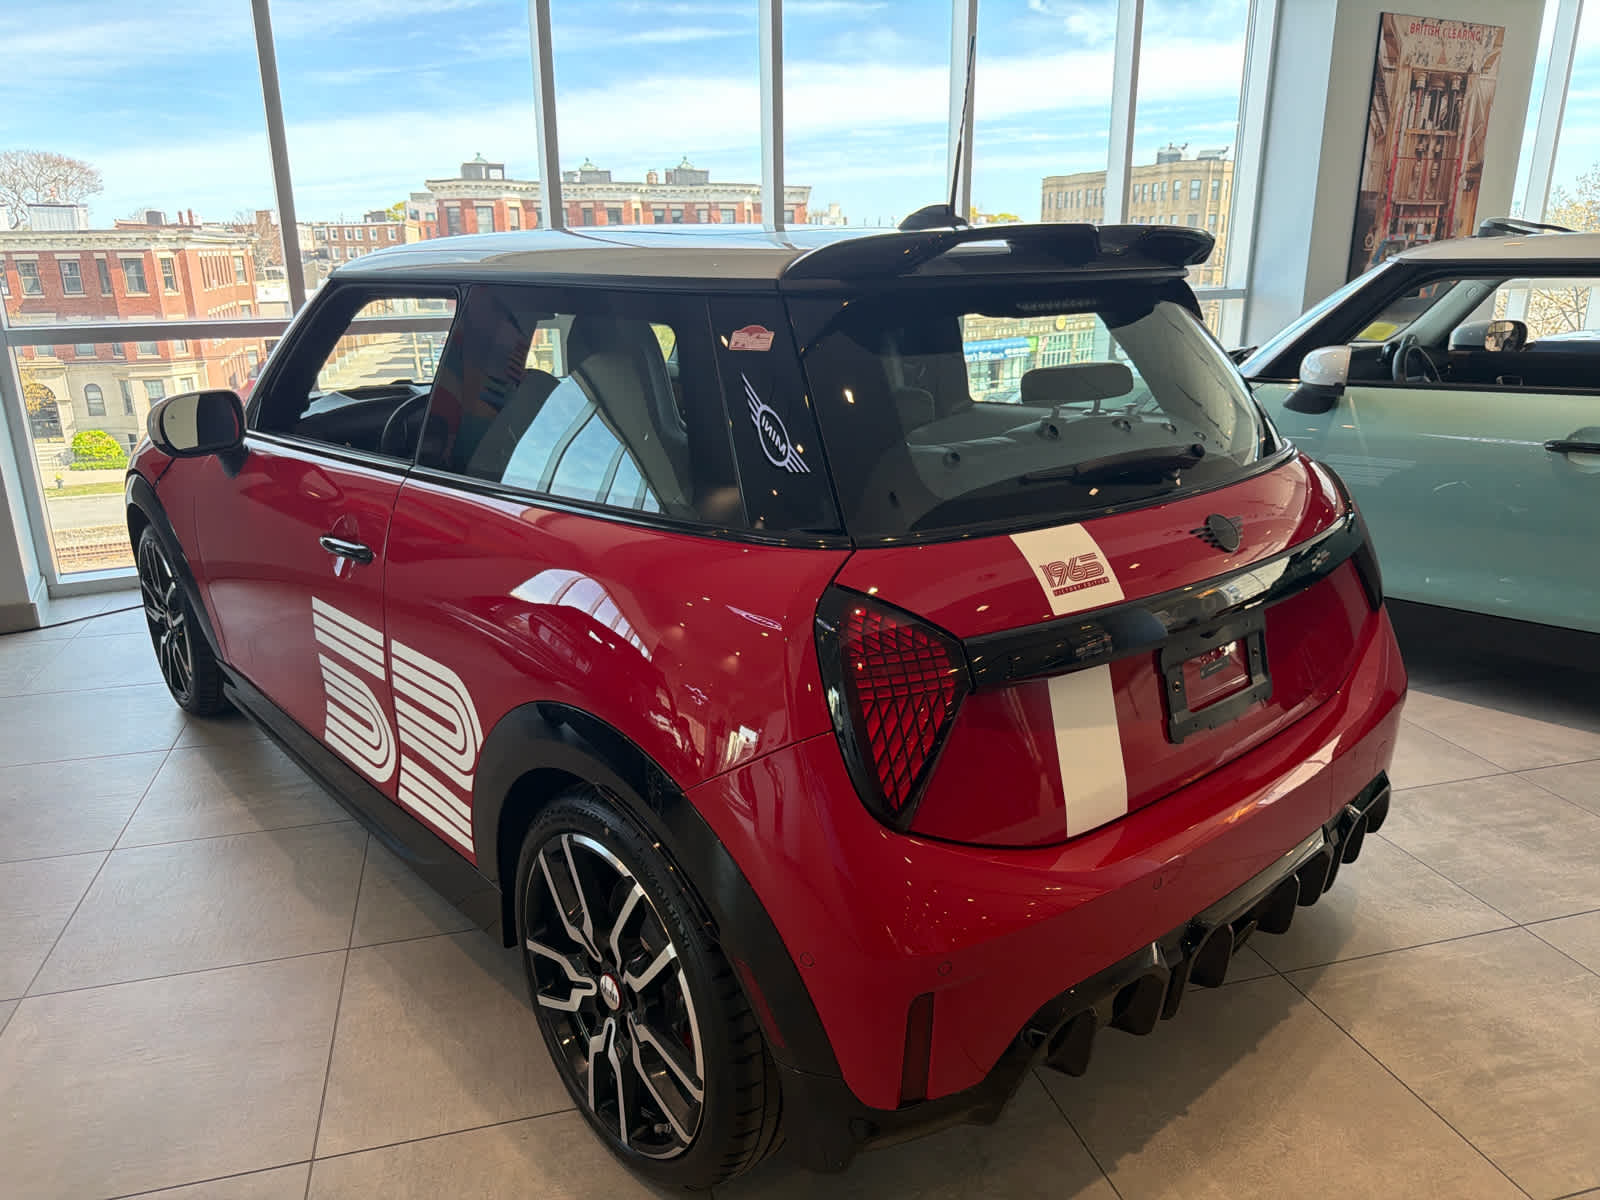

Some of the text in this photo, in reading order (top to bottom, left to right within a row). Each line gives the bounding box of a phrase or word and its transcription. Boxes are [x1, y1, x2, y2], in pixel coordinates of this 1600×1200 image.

[1409, 22, 1481, 42] BRITISH CLEARING
[1039, 552, 1104, 588] 1965
[1054, 577, 1109, 596] VICTORY EDITION
